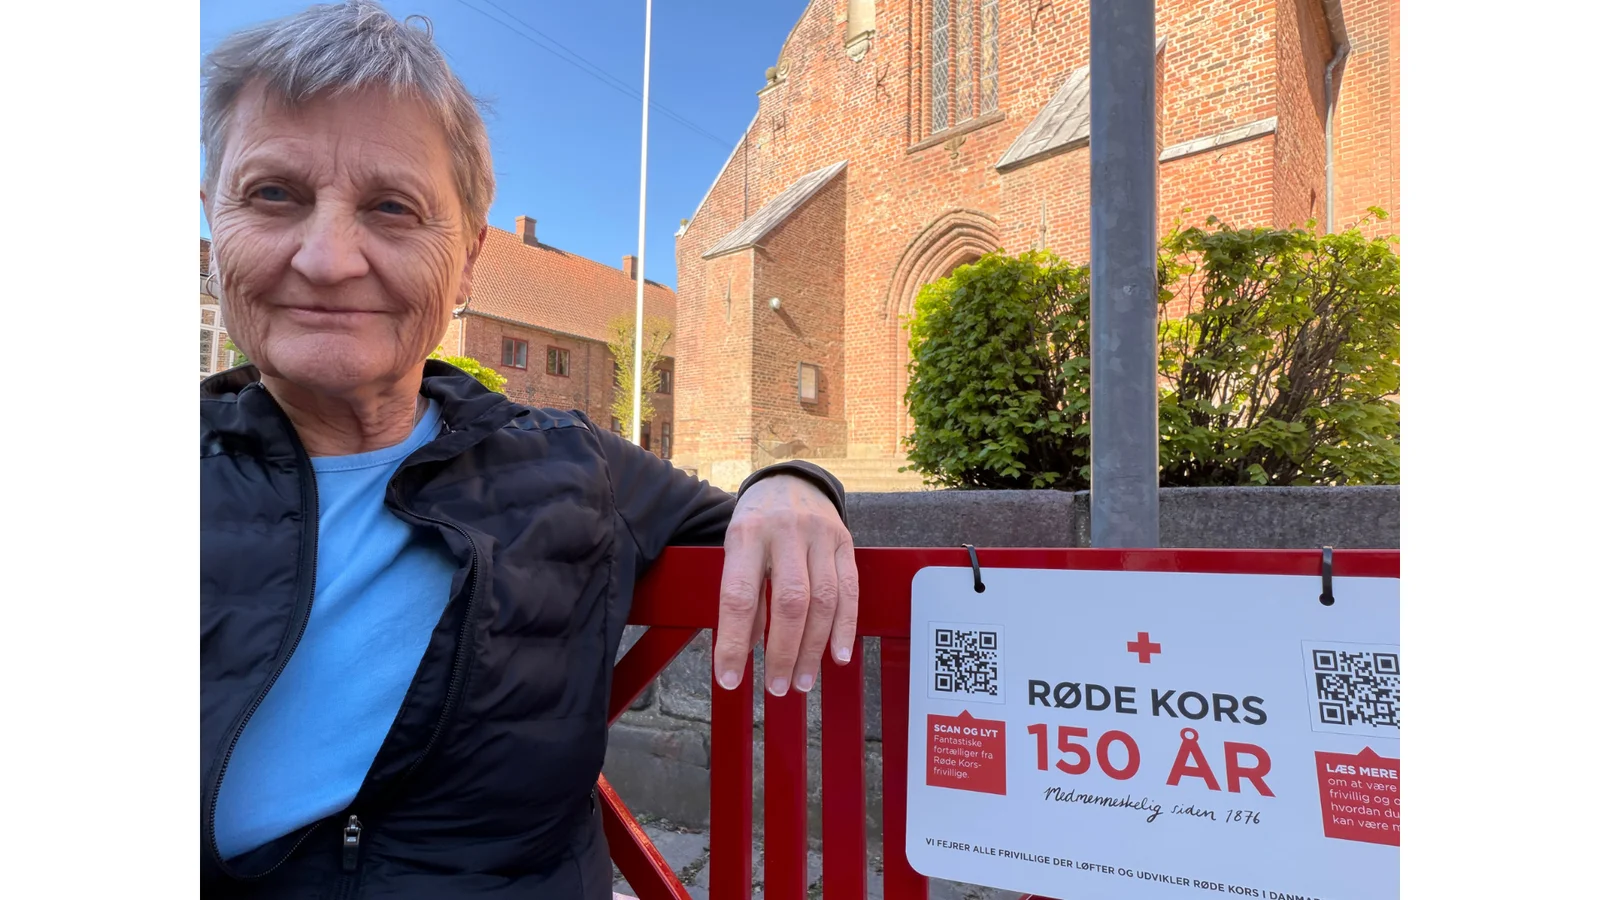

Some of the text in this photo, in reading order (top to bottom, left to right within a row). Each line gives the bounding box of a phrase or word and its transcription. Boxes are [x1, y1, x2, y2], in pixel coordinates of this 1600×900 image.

[1028, 679, 1267, 725] RØDE KORS
[934, 724, 998, 737] SCAN OG LYT
[934, 735, 982, 747] Fantastiske
[934, 756, 981, 768] Røde Kors-
[981, 751, 993, 759] fra
[1027, 723, 1276, 797] 150 ÅR
[934, 767, 969, 778] frivillige.
[1326, 763, 1398, 779] LÆS MERE
[1328, 778, 1397, 792] om at være
[1330, 789, 1369, 803] frivillig
[1374, 796, 1390, 805] og
[1044, 787, 1260, 824] Medmenneskelig siden 1876
[1331, 802, 1400, 818] hvordan du
[1333, 815, 1354, 826] kan
[1358, 820, 1388, 830] være
[937, 840, 970, 851] FEJRER
[973, 846, 996, 856] ALLE
[999, 850, 1050, 864] FRIVILLIGE
[1053, 858, 1073, 868] DER
[1076, 861, 1115, 874] LØFTER
[1118, 868, 1134, 878] OG
[1137, 871, 1190, 887] UDVIKLER
[1194, 880, 1224, 892] RØDE
[1228, 884, 1259, 897] KORS
[1262, 890, 1265, 898] I
